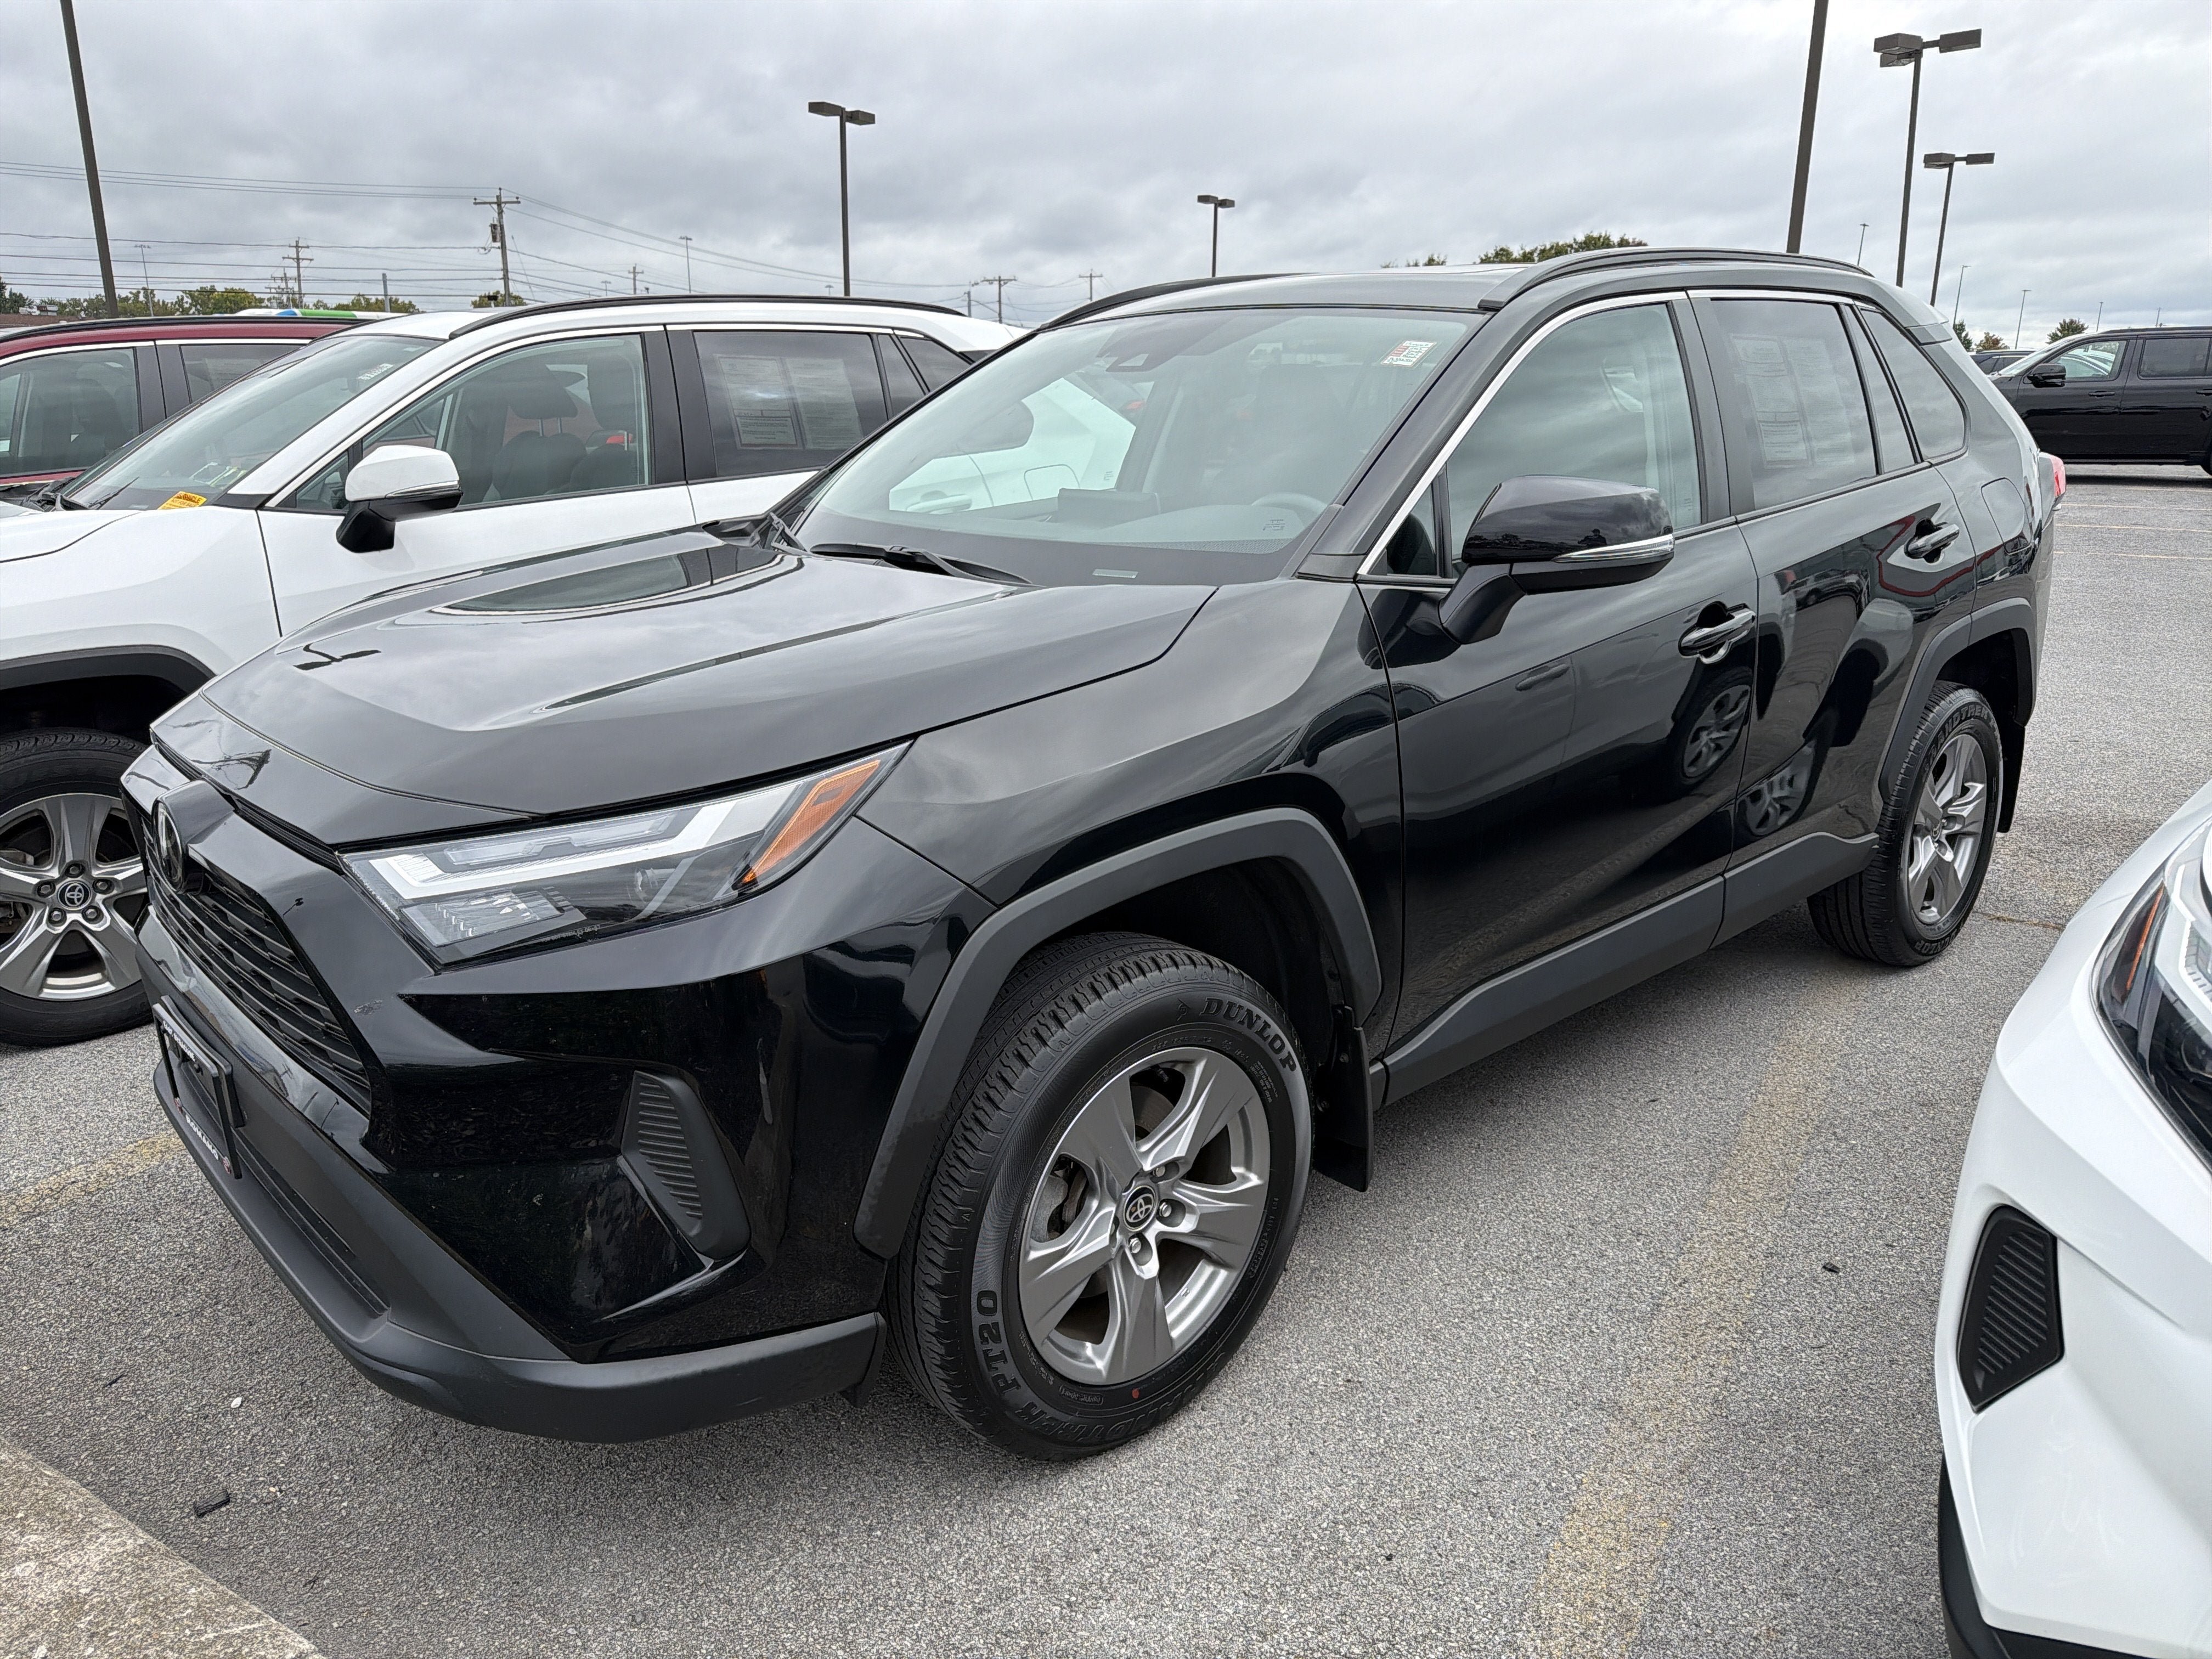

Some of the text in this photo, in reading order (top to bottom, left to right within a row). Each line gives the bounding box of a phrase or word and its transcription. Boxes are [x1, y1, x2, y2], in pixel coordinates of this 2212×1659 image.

[1199, 997, 1297, 1072] DUNLOP
[185, 1114, 219, 1160] ROMANO
[976, 1289, 1022, 1392] PT20
